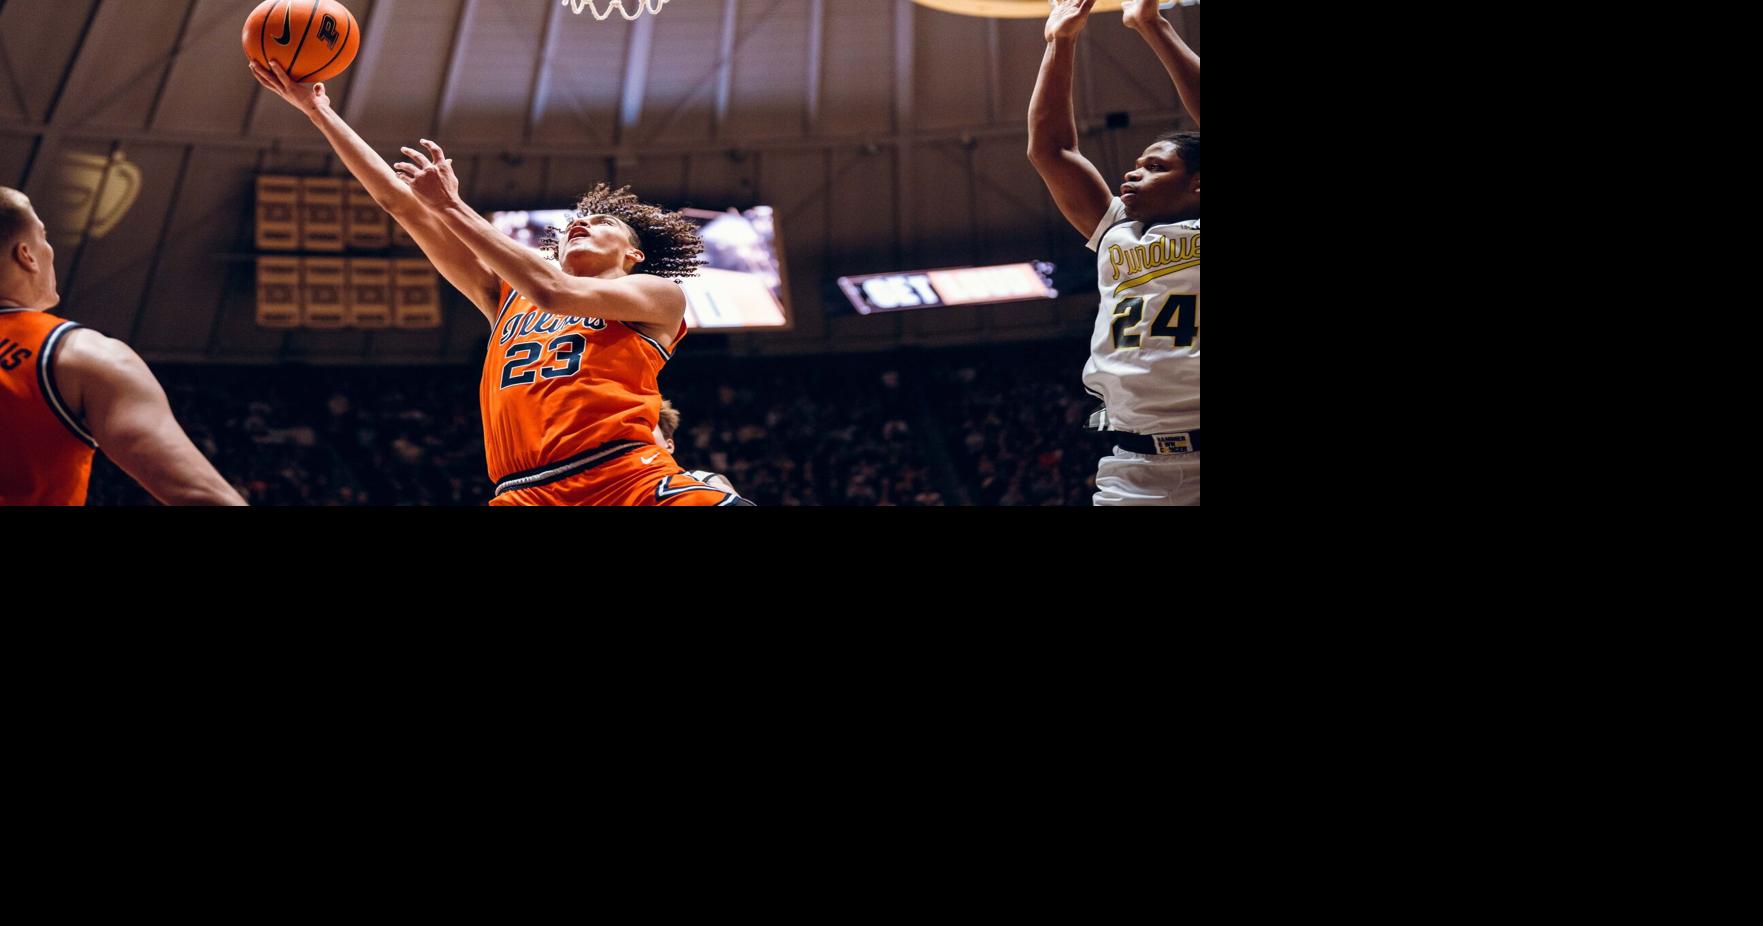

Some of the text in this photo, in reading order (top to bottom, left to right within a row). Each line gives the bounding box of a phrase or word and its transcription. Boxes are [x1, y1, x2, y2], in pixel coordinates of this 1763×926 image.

[317, 13, 339, 50] P
[1108, 233, 1200, 280] Purdue
[1111, 292, 1199, 350] 24
[500, 332, 586, 390] 23
